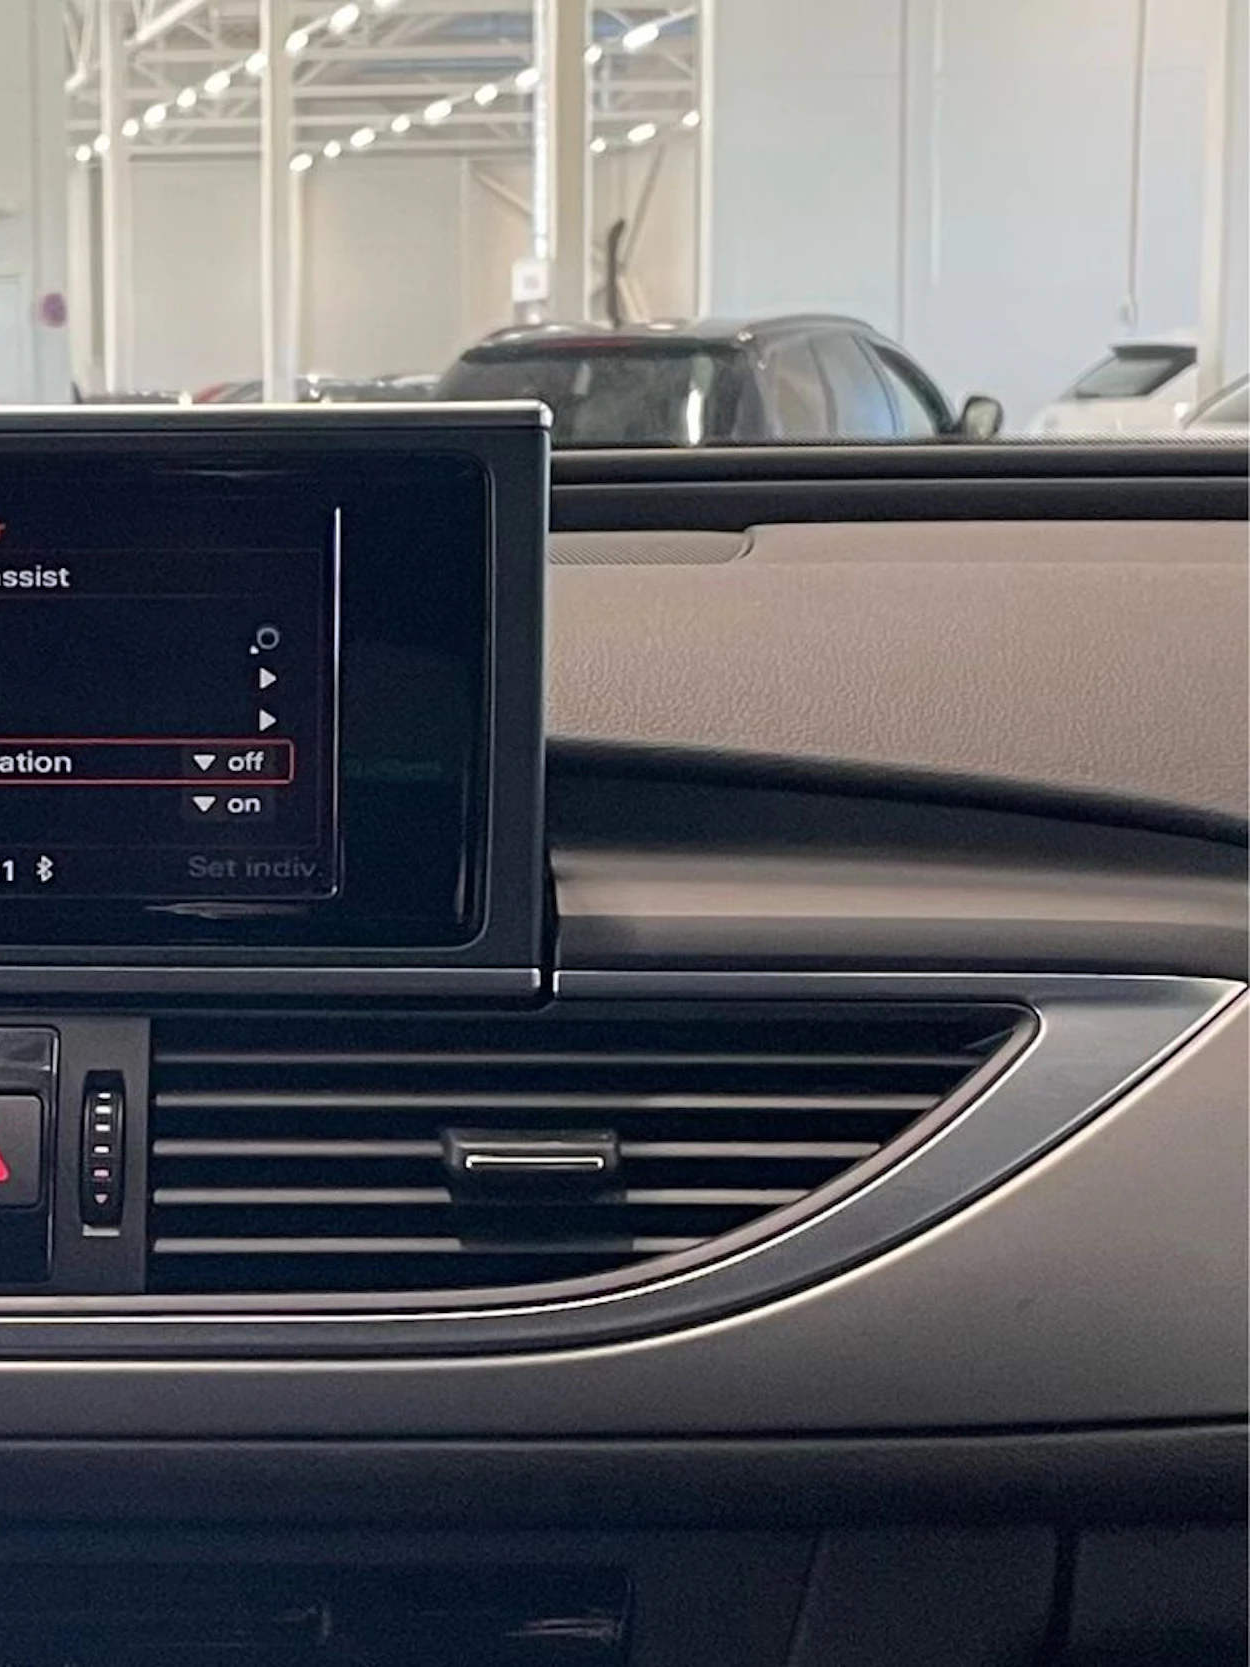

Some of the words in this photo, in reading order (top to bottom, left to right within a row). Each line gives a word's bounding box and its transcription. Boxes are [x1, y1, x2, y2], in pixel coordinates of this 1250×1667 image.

[227, 751, 264, 772] off
[227, 797, 261, 813] on
[188, 855, 237, 878] Set
